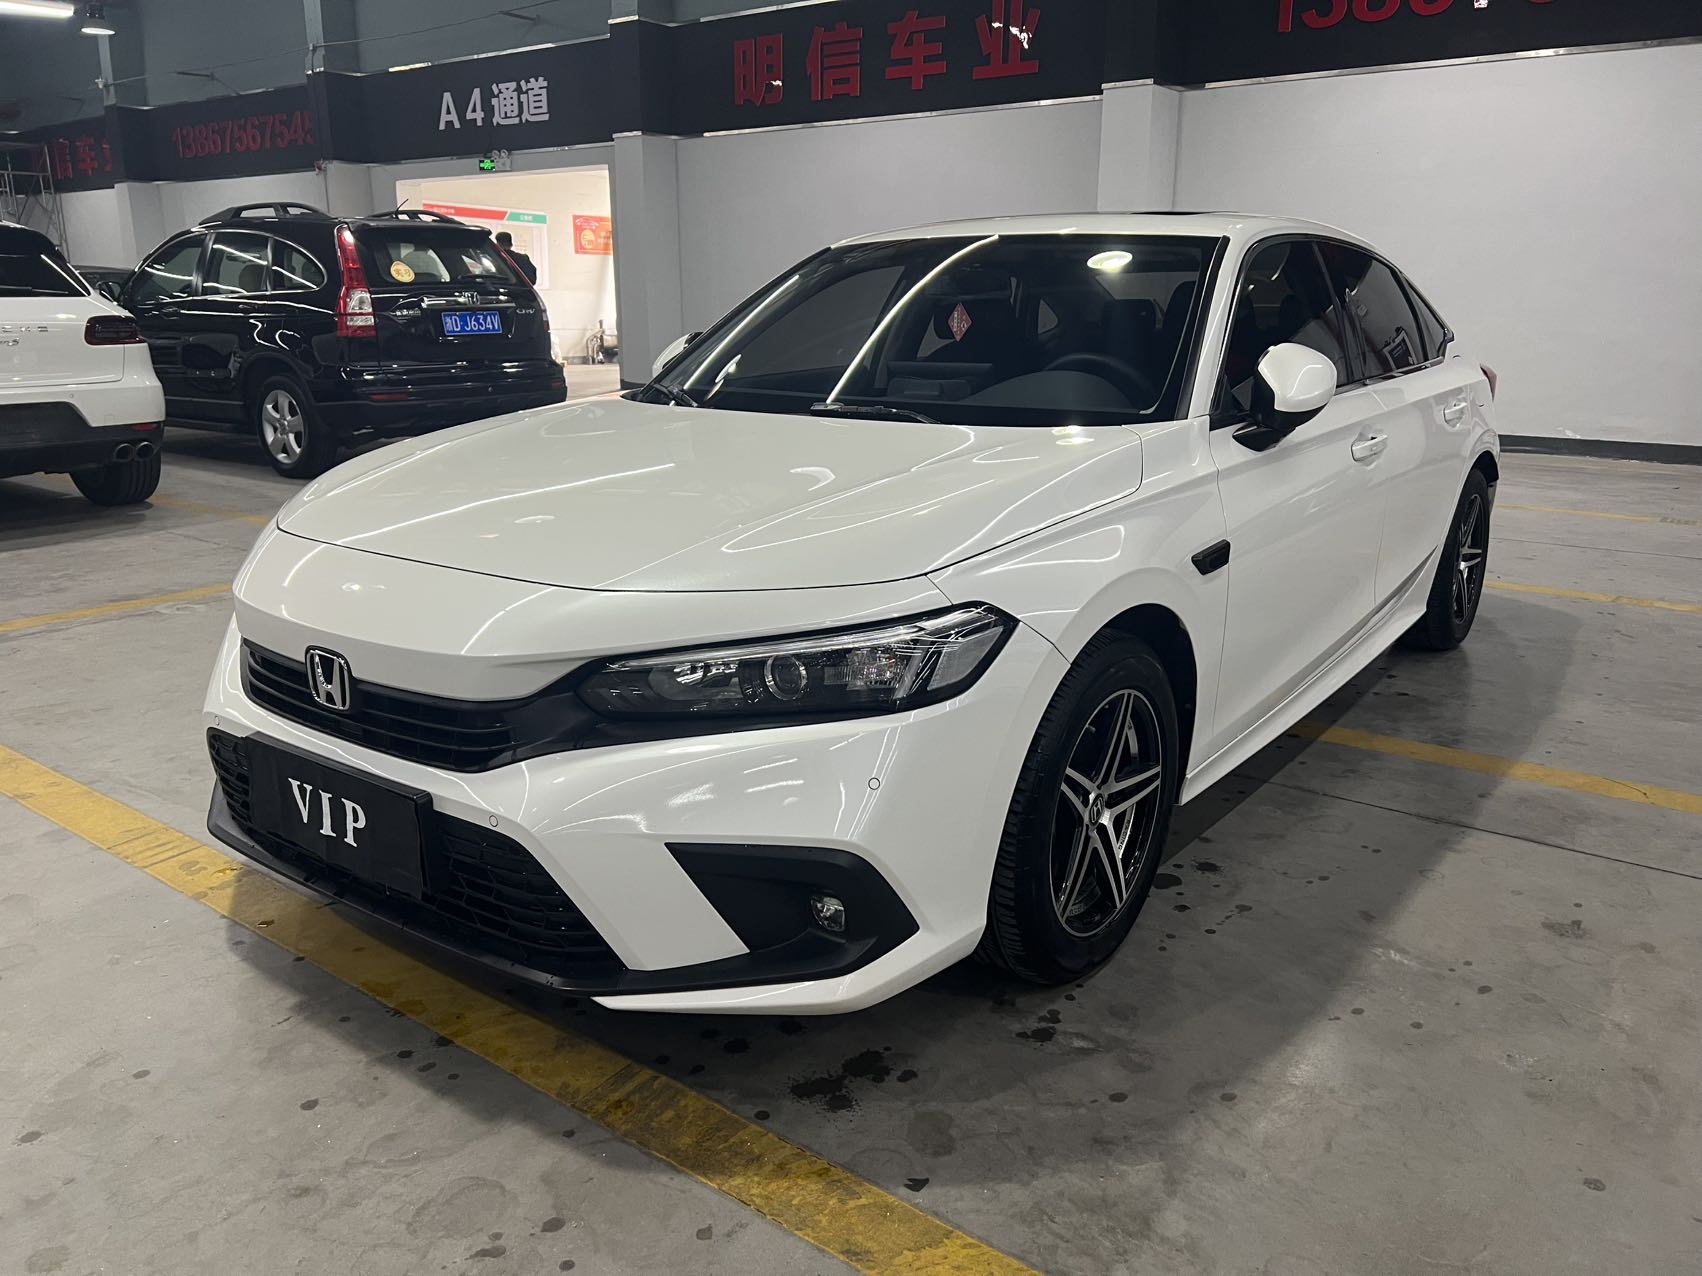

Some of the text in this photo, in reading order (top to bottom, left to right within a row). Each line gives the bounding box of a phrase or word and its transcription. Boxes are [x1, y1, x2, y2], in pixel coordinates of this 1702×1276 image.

[733, 0, 1041, 107] 明信车业
[287, 777, 368, 849] VIP
